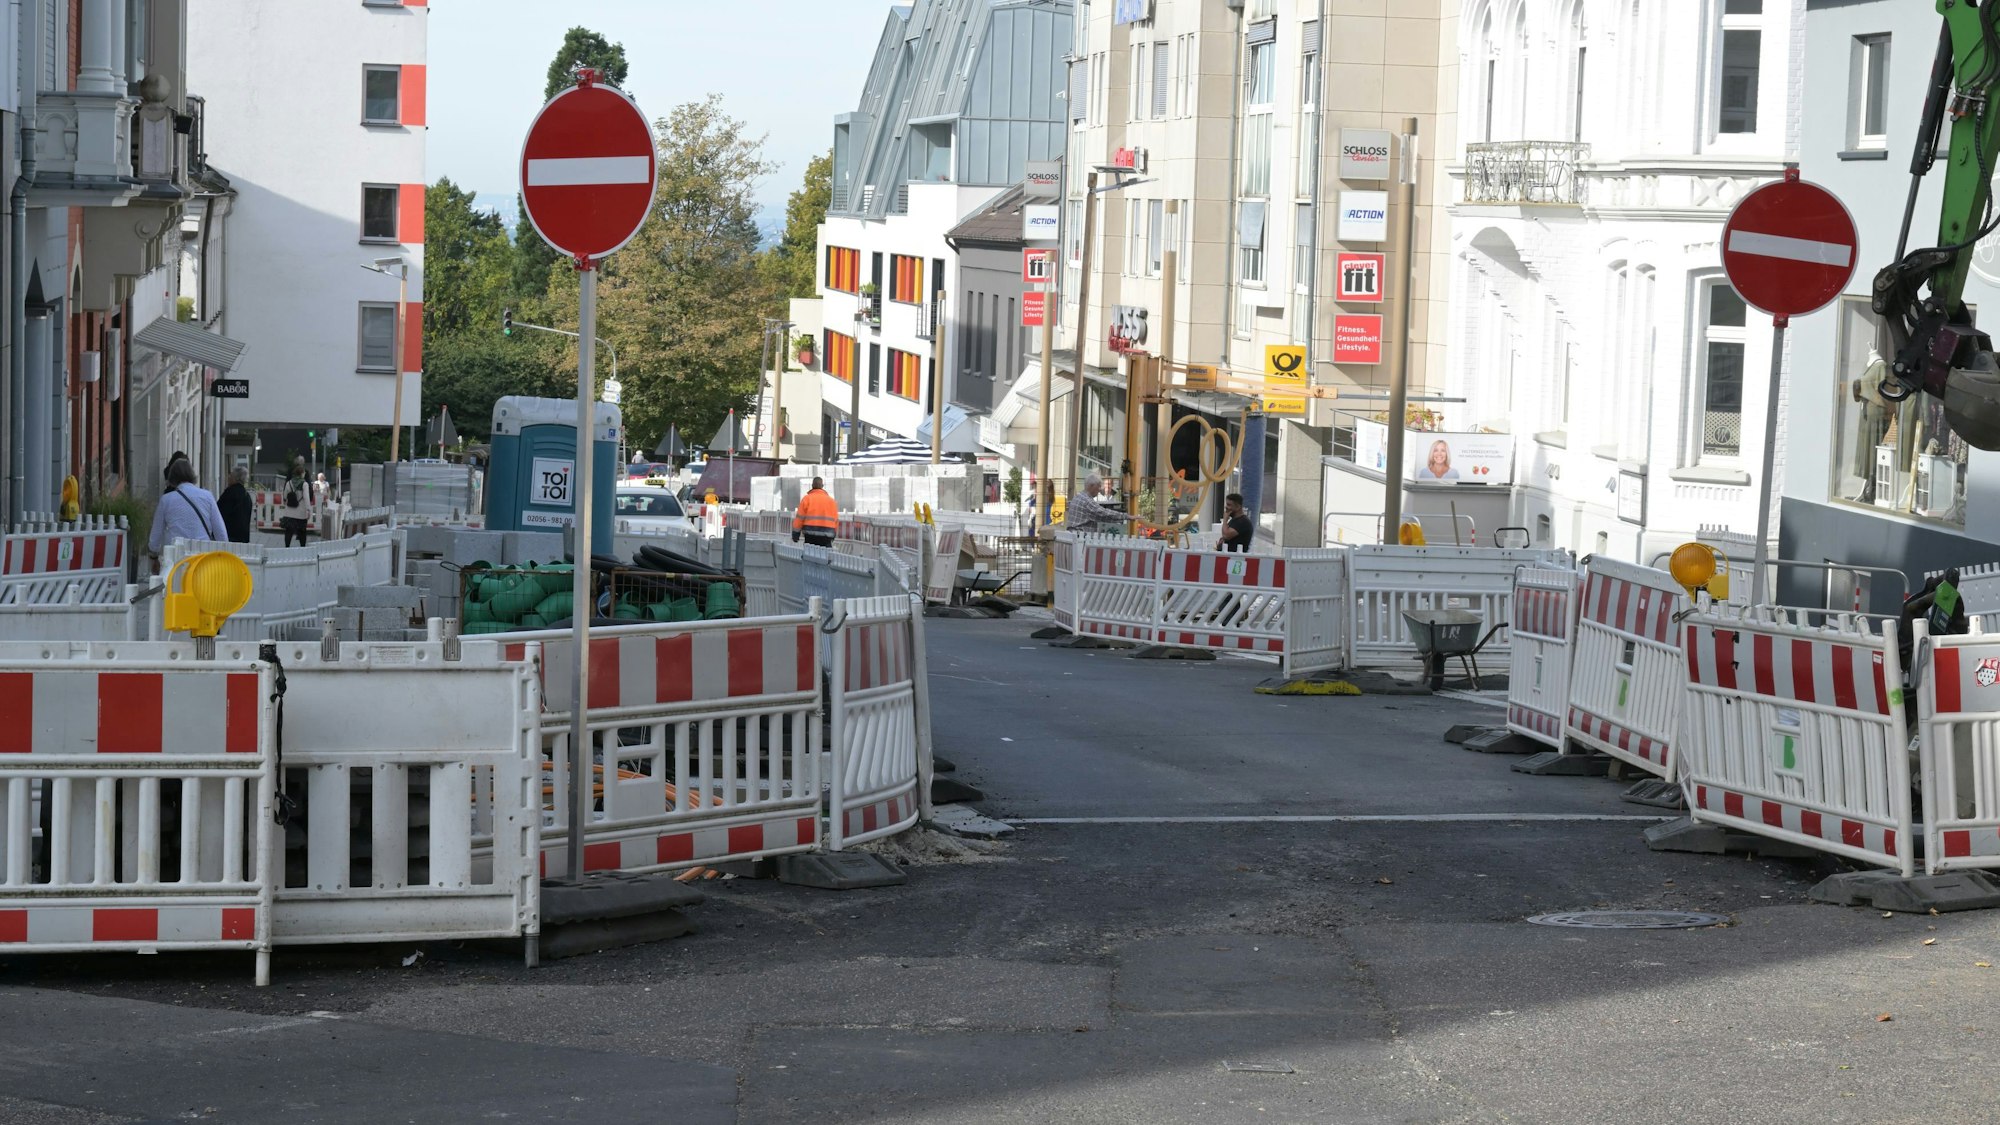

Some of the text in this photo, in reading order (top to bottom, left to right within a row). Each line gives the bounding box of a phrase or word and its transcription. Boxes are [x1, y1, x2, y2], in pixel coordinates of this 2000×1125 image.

[1343, 145, 1388, 156] SCHLOSS
[1351, 153, 1380, 162] Center
[1348, 209, 1384, 219] ACTION
[1030, 217, 1057, 225] ACTION
[1344, 262, 1375, 270] clever
[1344, 268, 1375, 293] fit
[1336, 334, 1380, 342] Gesundheit.
[1336, 343, 1371, 352] Lifestyle.
[217, 384, 248, 394] BABOR
[542, 471, 568, 486] TOI
[541, 485, 567, 500] TOI
[527, 515, 547, 523] 02056
